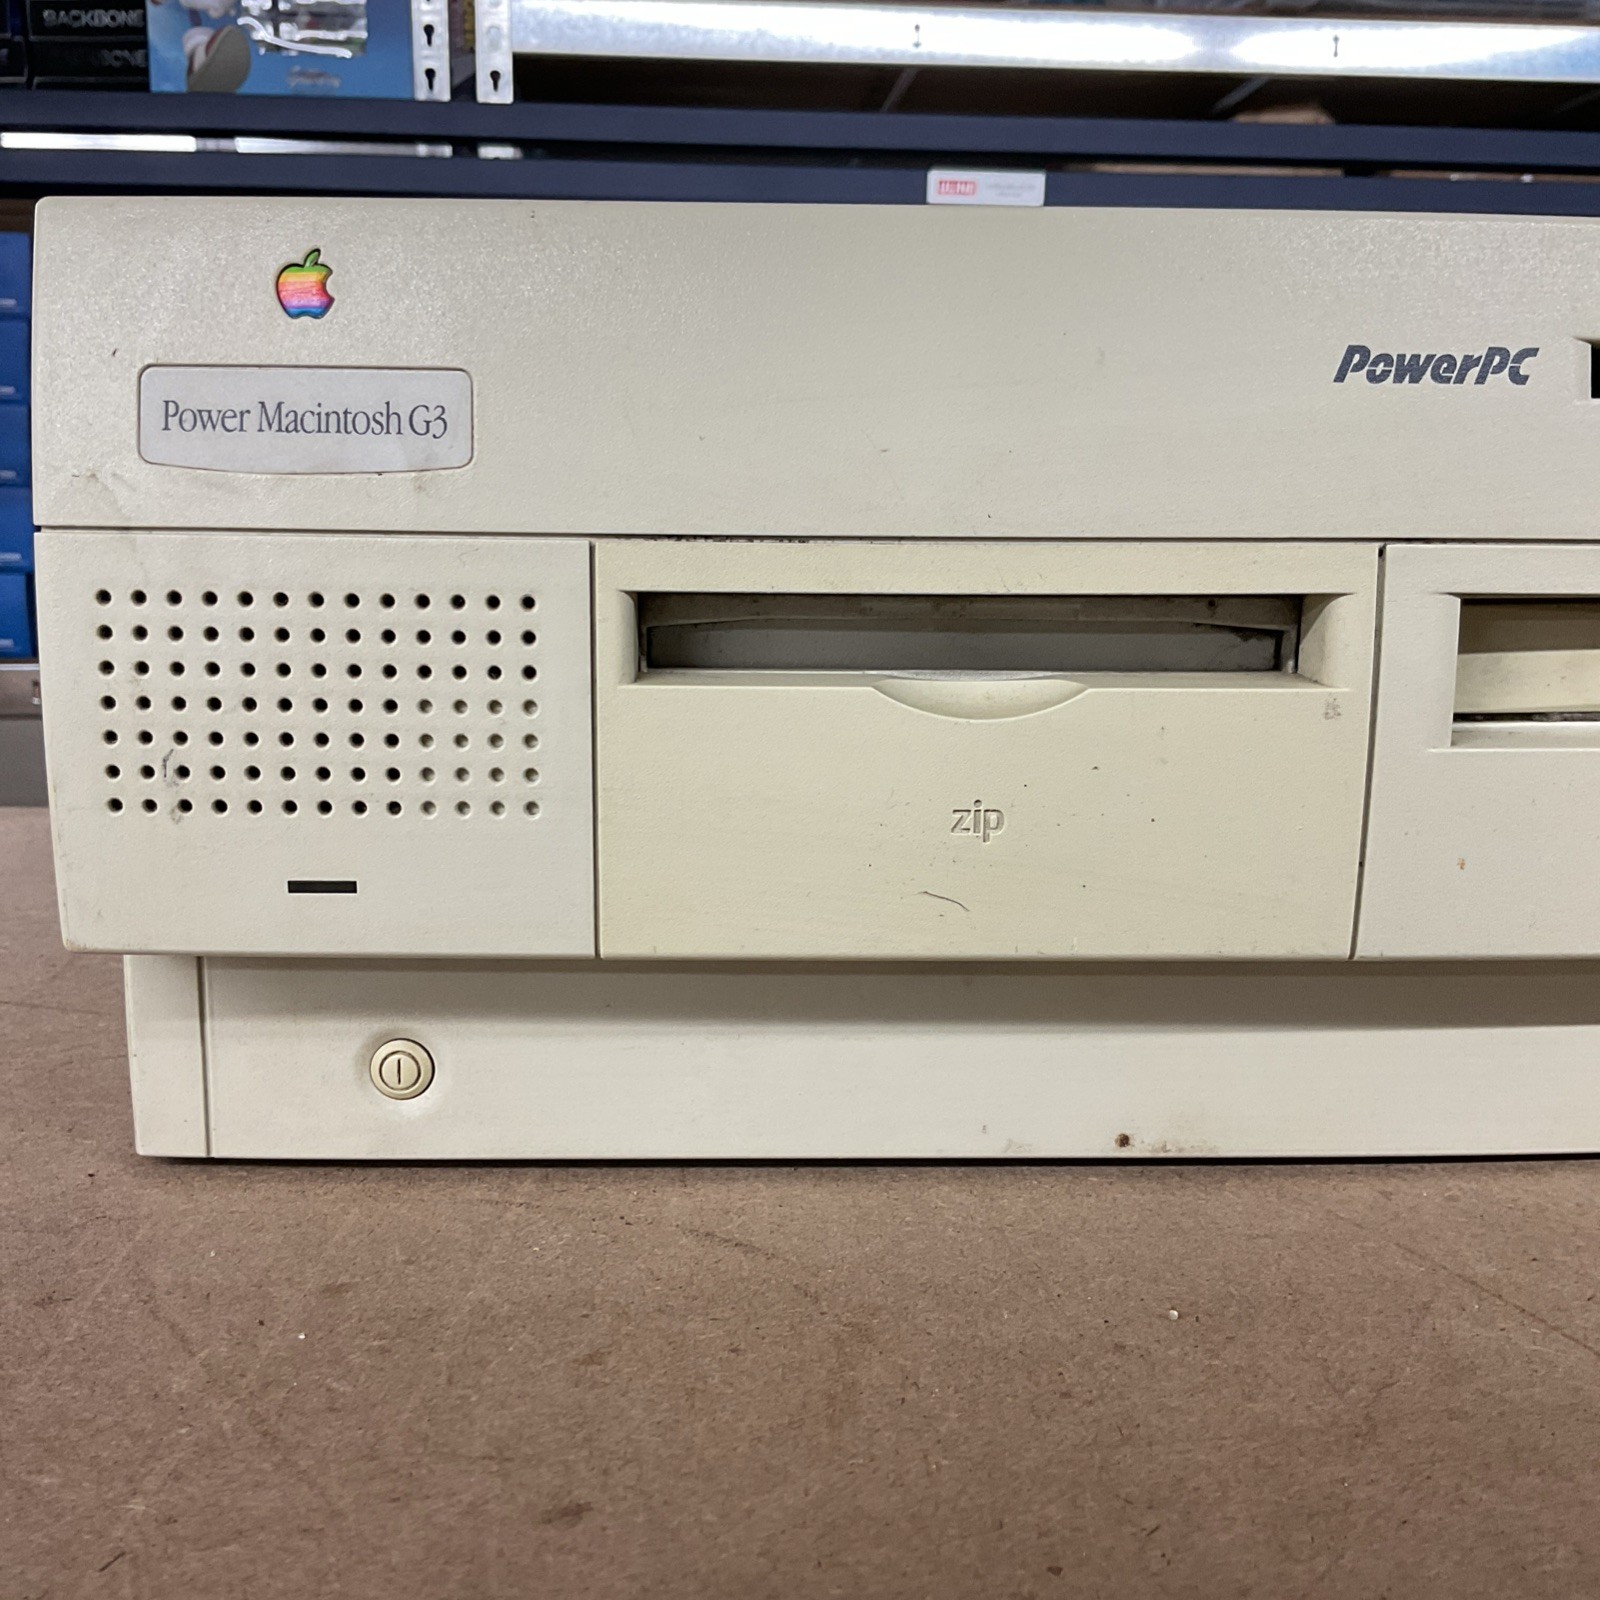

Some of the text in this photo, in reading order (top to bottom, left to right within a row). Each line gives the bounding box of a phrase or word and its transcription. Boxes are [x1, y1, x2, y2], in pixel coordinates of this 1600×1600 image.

[1333, 344, 1540, 385] PowerPC
[161, 400, 448, 439] Power Macintosh G3
[950, 799, 1005, 843] zip
